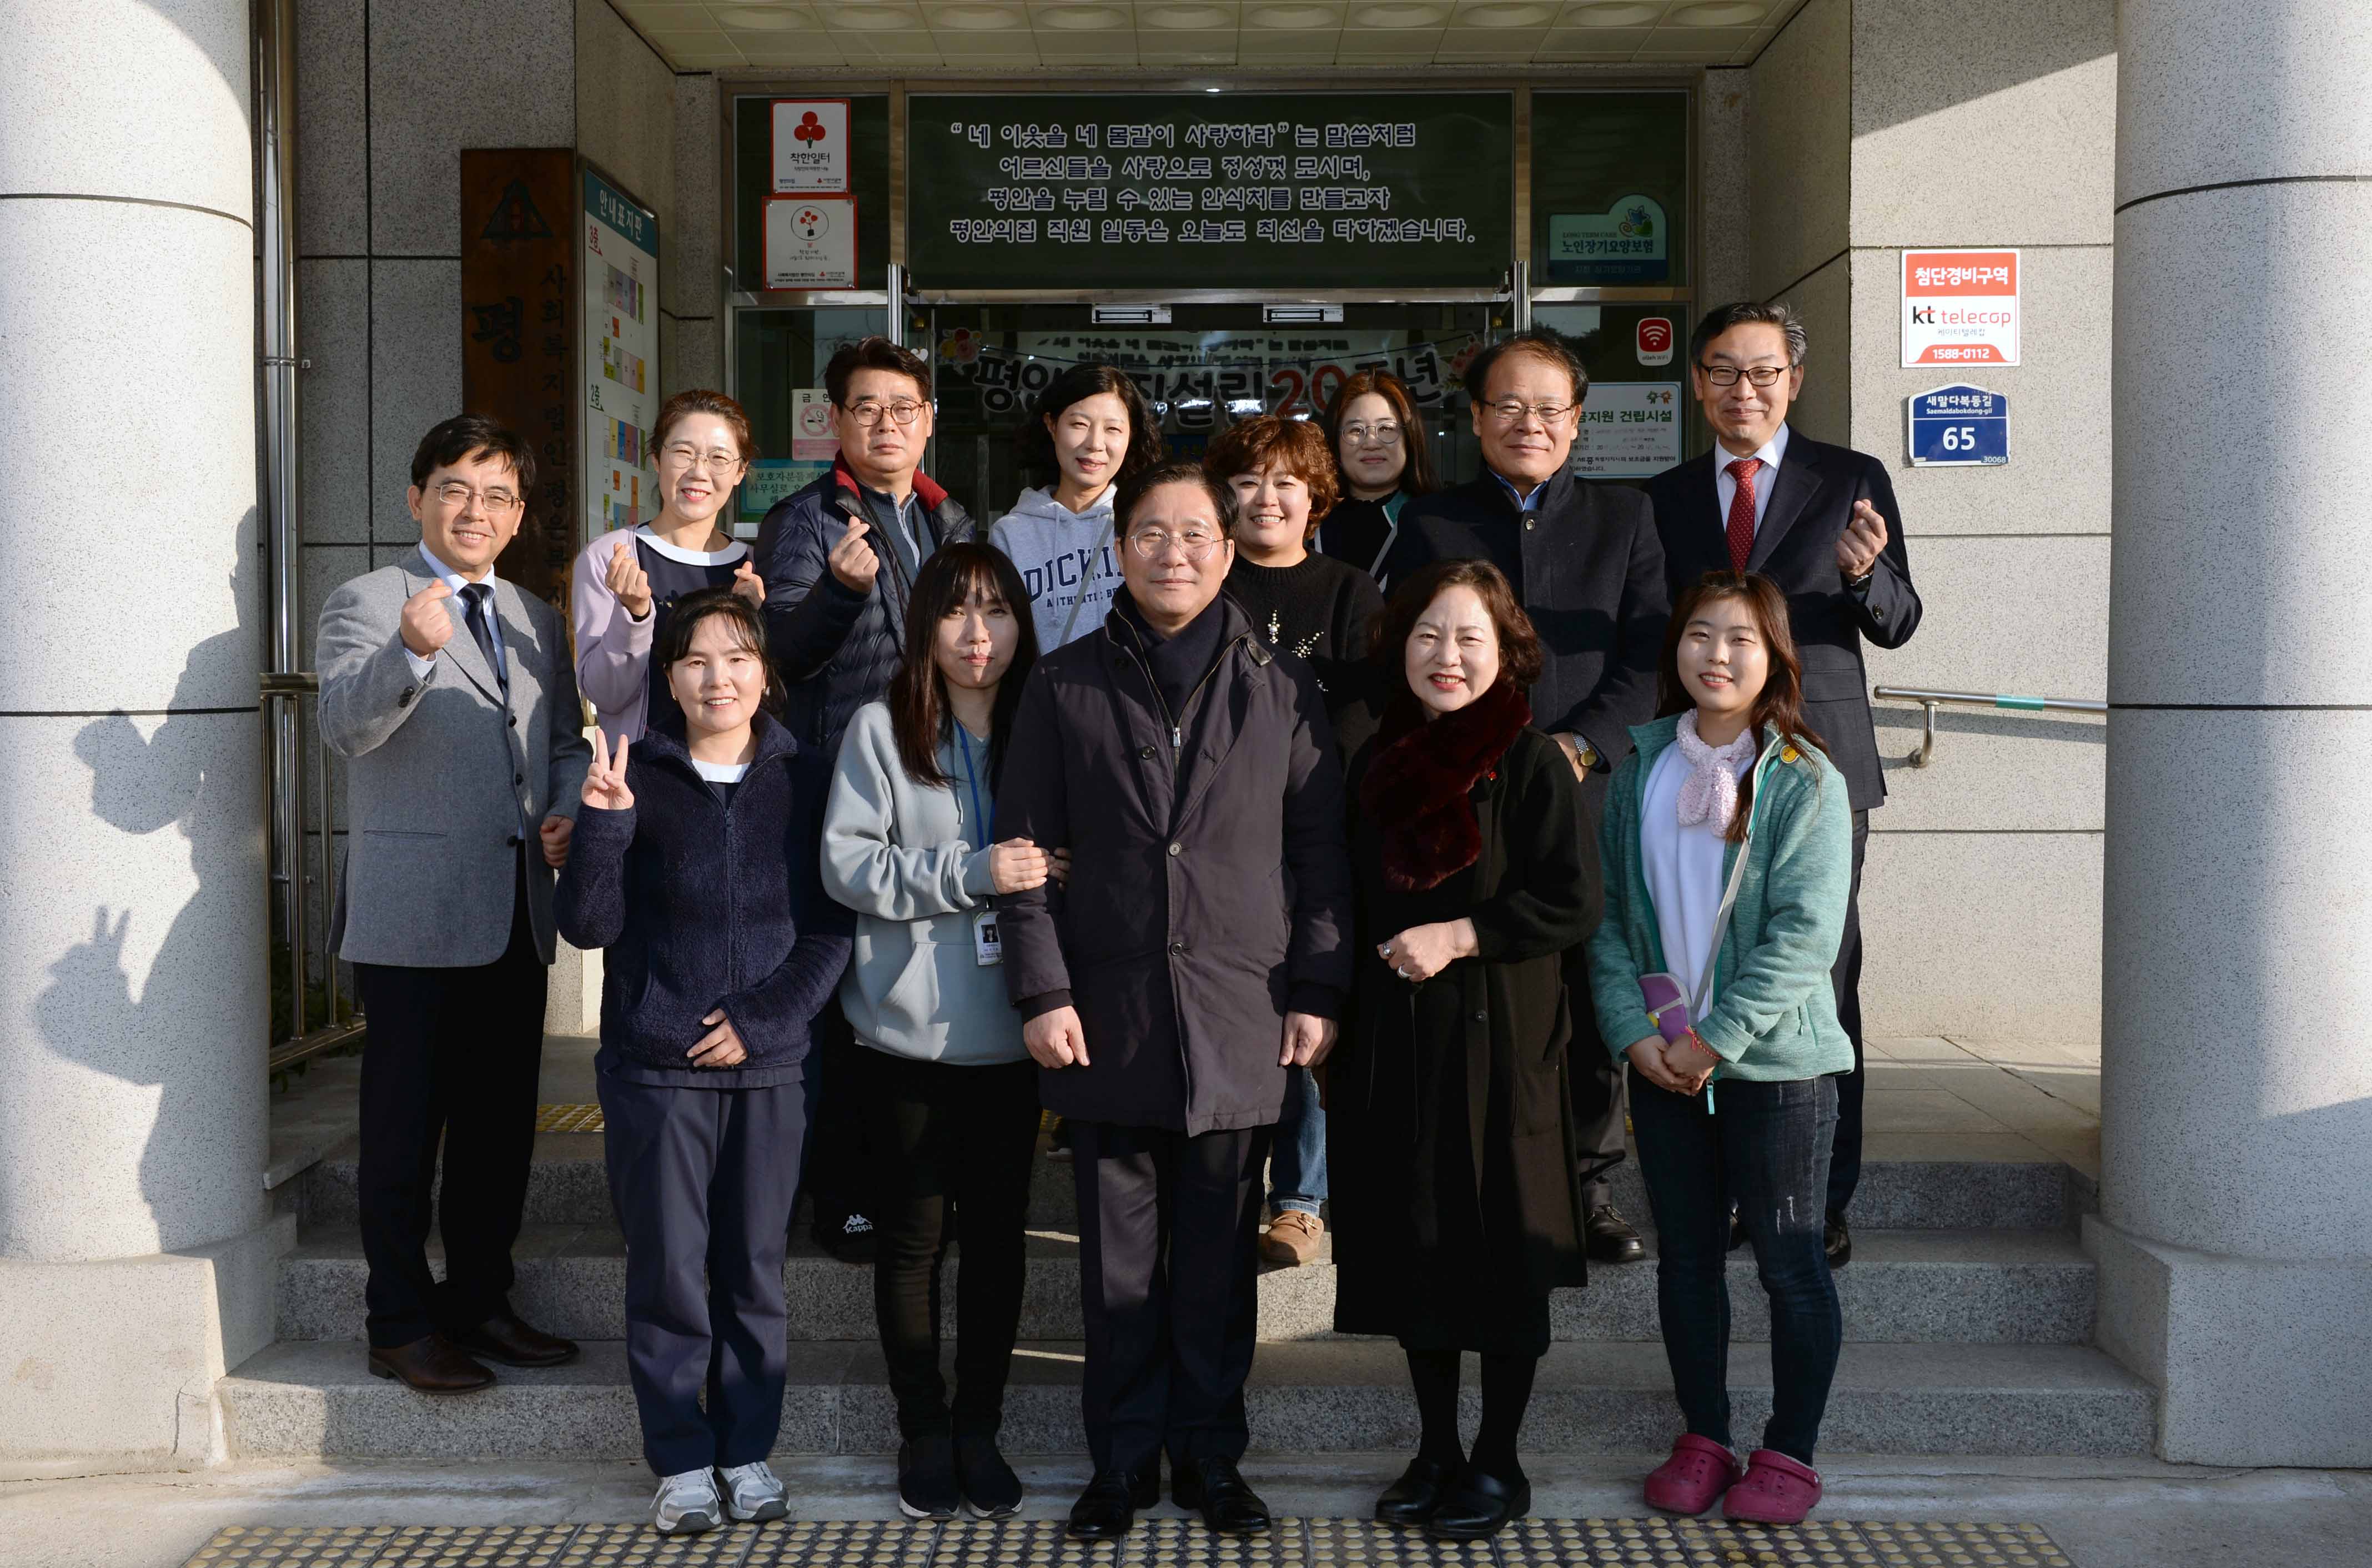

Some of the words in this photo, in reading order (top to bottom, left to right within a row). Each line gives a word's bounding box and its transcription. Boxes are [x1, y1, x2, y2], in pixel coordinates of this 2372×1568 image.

[1000, 123, 1068, 149] 이웃을
[1075, 123, 1098, 149] 네
[1107, 123, 1174, 148] 몸같이
[1325, 123, 1416, 148] 말씀처럼
[791, 153, 830, 164] 착한일터
[999, 155, 1112, 180] 어르신들을
[1121, 155, 1213, 180] 사랑으로
[1221, 155, 1286, 180] 정성껏
[1294, 154, 1371, 182] 모시며,
[987, 187, 1056, 212] 평안을
[1063, 187, 1108, 212] 누릴
[1116, 187, 1140, 212] 수
[1148, 187, 1193, 212] 있는
[1201, 186, 1292, 212] 안식처를
[1300, 186, 1391, 211] 만들고자
[600, 189, 642, 241] 안내표지판
[590, 225, 599, 249] 3층
[949, 218, 1037, 243] 평안의집
[1047, 218, 1091, 244] 직원
[1101, 218, 1169, 243] 일동은
[1177, 219, 1247, 243] 오늘도
[1256, 218, 1325, 243] 최선을
[1333, 218, 1475, 243] 다하겠습니다.
[1561, 239, 1654, 254] 노인장기요양보험
[1916, 267, 2008, 286] 첨단경비구역
[1913, 306, 1936, 324] kt
[1941, 309, 2011, 327] telecop
[1933, 348, 1989, 359] 1588-0112
[1926, 395, 1992, 408] 새말다복동길
[1926, 407, 1993, 415] Saemaldabokdong-gil
[1620, 410, 1672, 423] 건립시설
[1943, 426, 1976, 450] 65
[1983, 456, 2007, 464] 30068
[1023, 546, 1123, 603] DICKI
[1047, 594, 1103, 607] ATHNTI
[846, 1224, 873, 1234] Kappa
